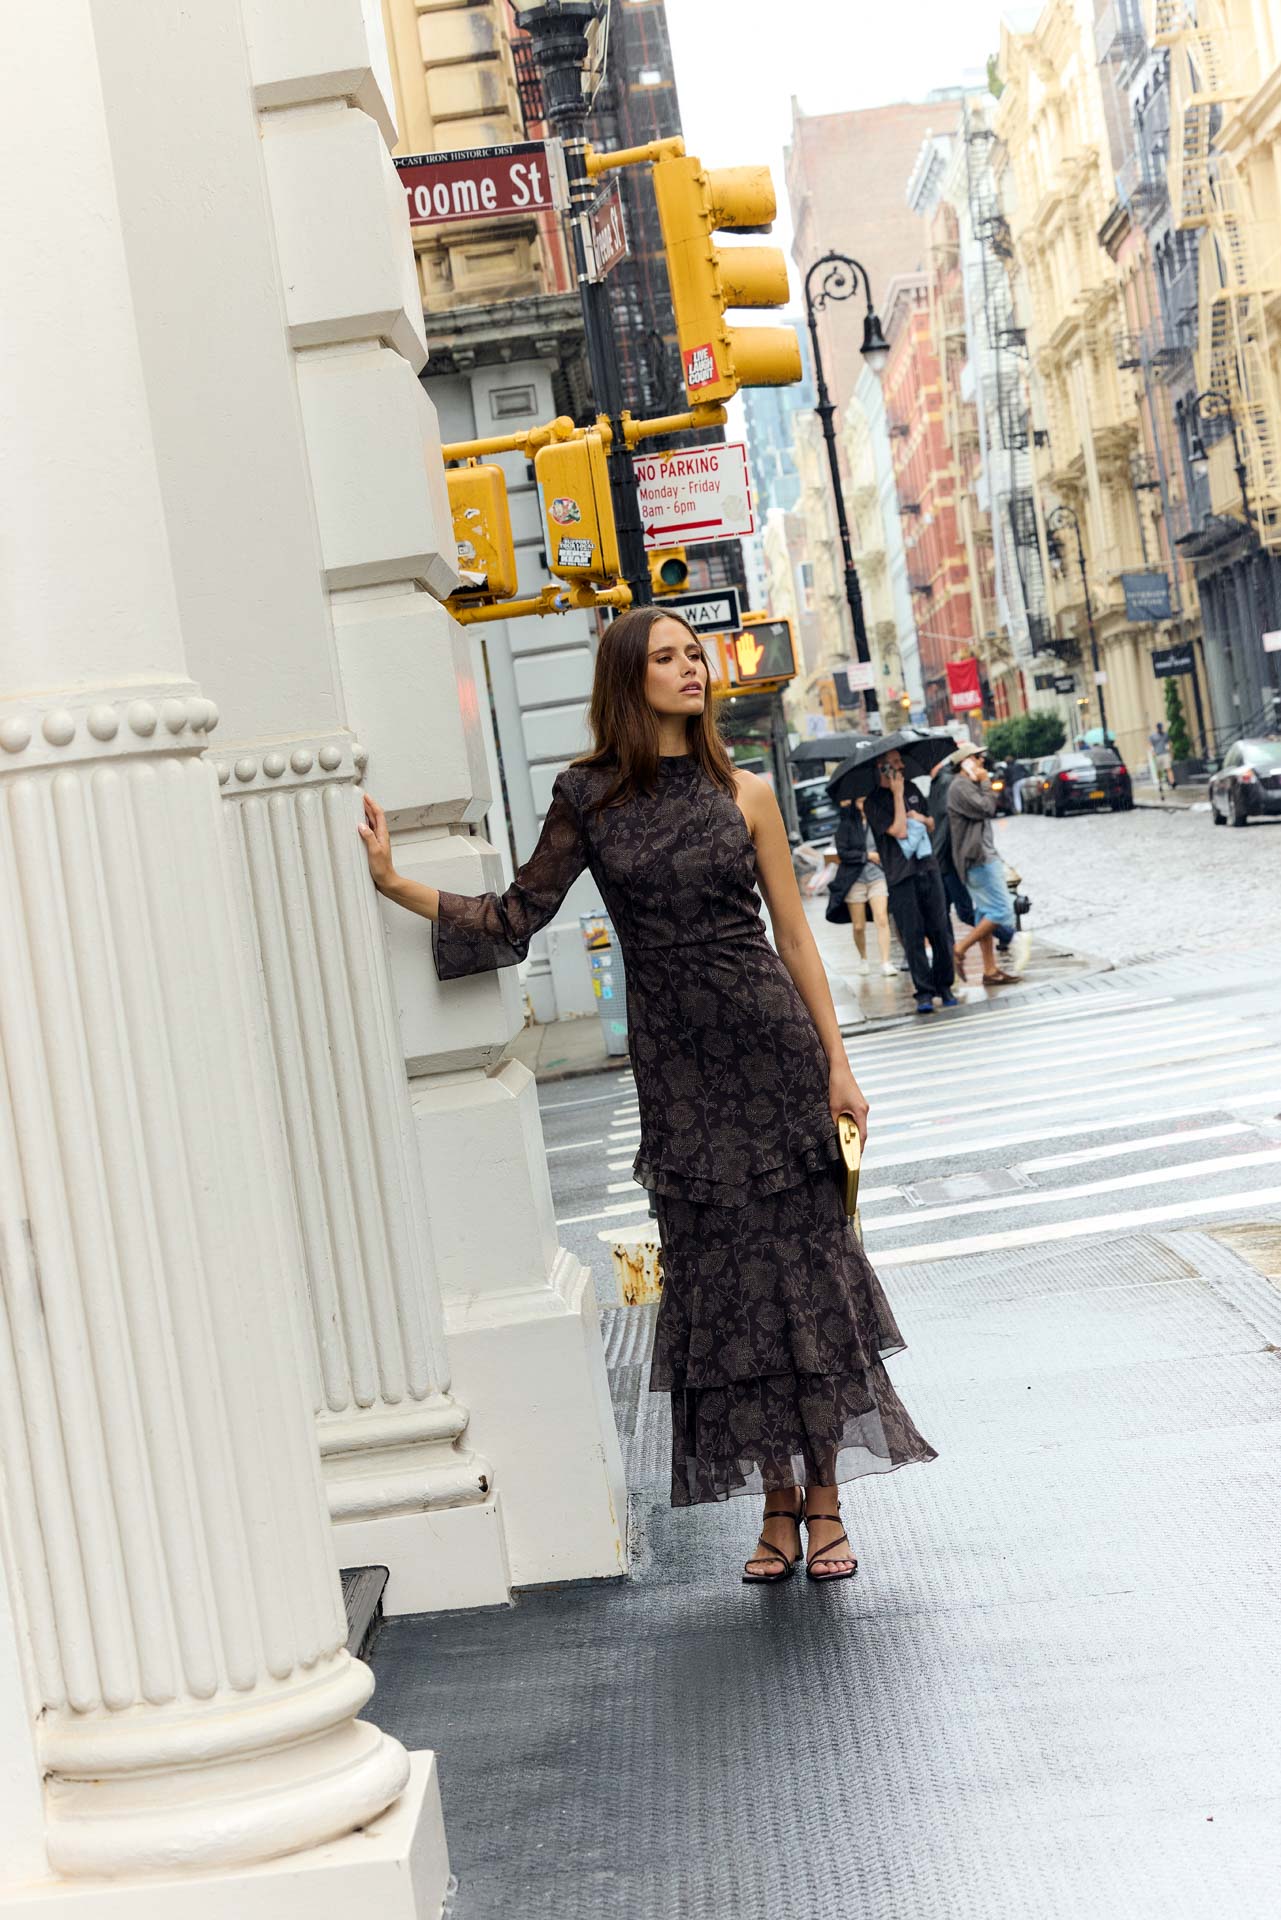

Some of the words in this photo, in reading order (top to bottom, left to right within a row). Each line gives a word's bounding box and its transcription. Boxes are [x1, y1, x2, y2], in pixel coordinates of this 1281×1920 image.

[426, 154, 448, 164] IRON
[451, 149, 490, 161] HISTORIC
[494, 146, 514, 156] DIST
[509, 161, 545, 206] St
[693, 347, 709, 362] LIVE
[688, 356, 713, 375] LAUGH
[688, 367, 713, 385] COUNT
[637, 465, 656, 482] NO
[660, 455, 719, 479] PARKING
[639, 485, 678, 501] Monday
[689, 479, 720, 495] Friday
[642, 504, 664, 518] 8am
[673, 500, 696, 516] 6pm
[684, 604, 721, 622] WAY
